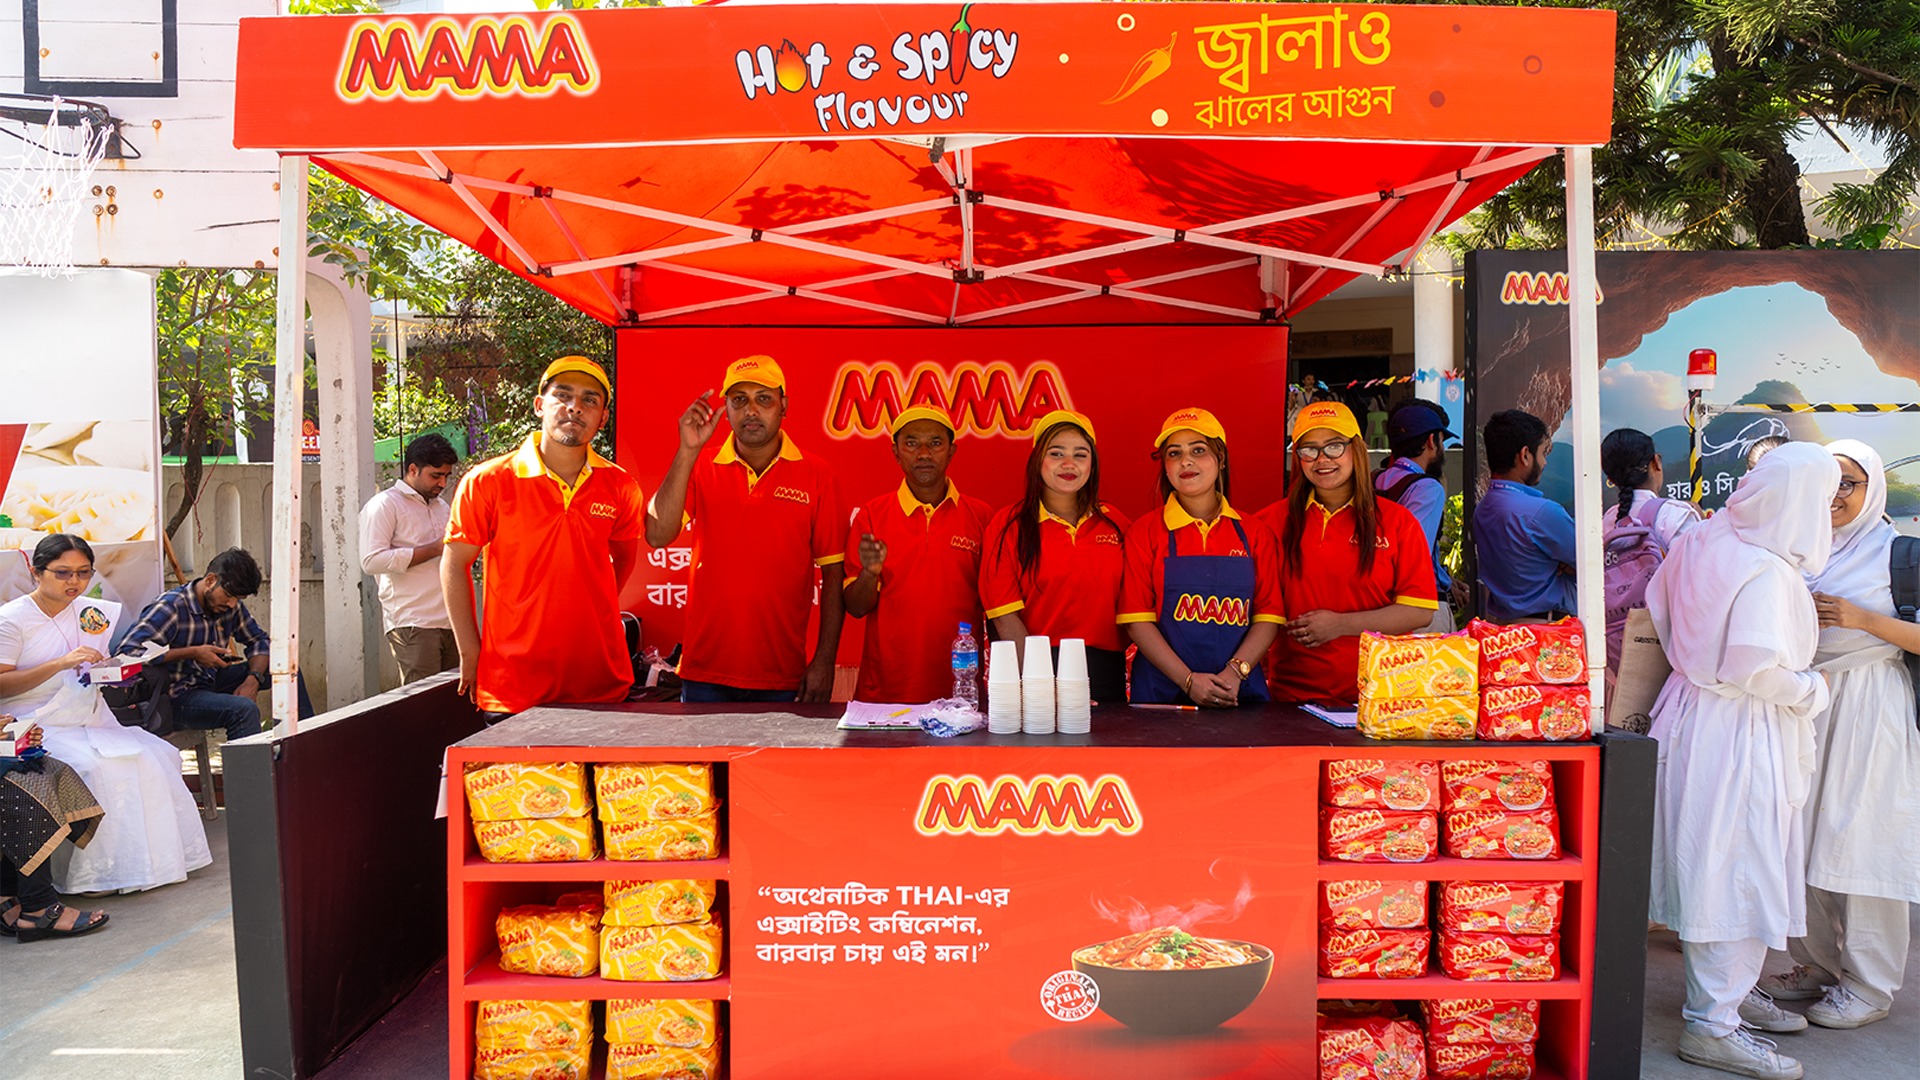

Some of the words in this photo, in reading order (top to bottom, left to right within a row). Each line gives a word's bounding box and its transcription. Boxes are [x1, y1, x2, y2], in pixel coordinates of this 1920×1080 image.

[341, 20, 595, 96] MAMA
[735, 38, 831, 99] Hot
[847, 44, 880, 80] &
[891, 4, 1018, 85] Spicy
[1194, 7, 1391, 94] জ্বালাও
[814, 91, 968, 132] Flavour
[1194, 93, 1296, 129] ঝালের
[1302, 86, 1396, 119] আগুন
[1503, 272, 1602, 304] MAM
[735, 361, 759, 372] MAMA
[1311, 408, 1338, 417] MAMA
[774, 487, 810, 504] MAMA
[1483, 627, 1536, 655] MAMA
[1379, 648, 1425, 671] MAMA
[1379, 700, 1425, 716] MAMA
[1486, 685, 1541, 710] MAMA
[469, 769, 512, 793] MAMA
[601, 775, 645, 797] MAMA
[920, 777, 1138, 833] MAMA
[480, 821, 522, 845] MAMA
[1331, 810, 1384, 836] MAMA
[758, 882, 889, 906] “অথেনটিক
[896, 886, 1010, 908] THAI-এর
[1455, 884, 1510, 905] MAMA
[756, 910, 862, 936] এক্সাইটিং
[868, 911, 983, 936] কম্বিনেশন,
[609, 929, 654, 952] MAMA
[756, 943, 836, 965] বারবার
[843, 944, 884, 965] চায়
[892, 941, 927, 964] এই
[1454, 938, 1510, 964] MAMA
[1044, 973, 1090, 998] ORIGINAL
[1055, 987, 1087, 1005] THAI
[1057, 1000, 1095, 1019] RECIPE
[1321, 1028, 1373, 1060] MAMA
